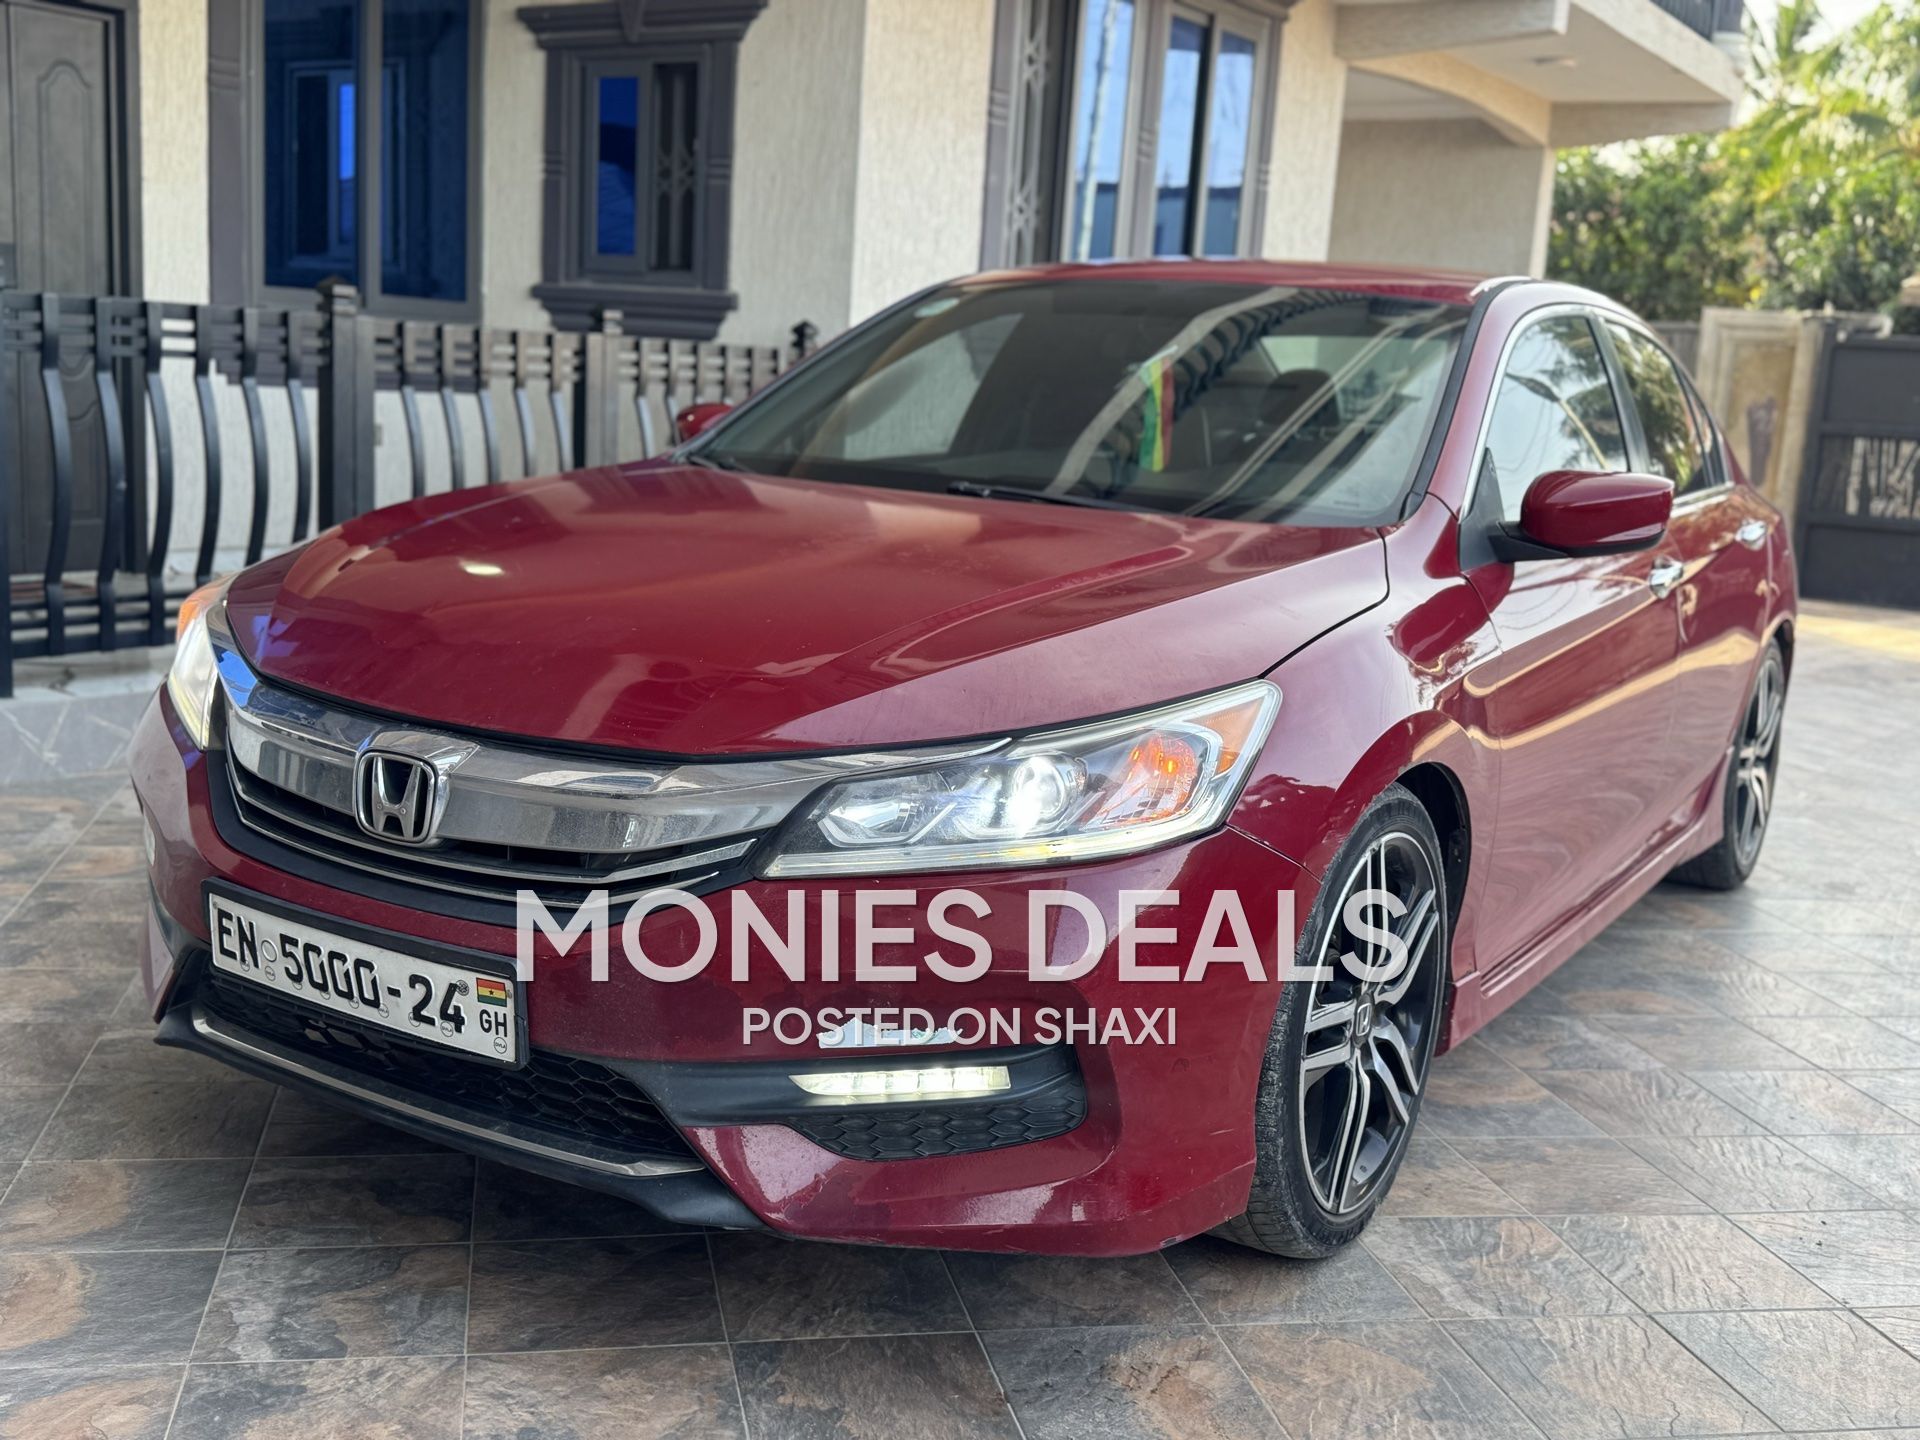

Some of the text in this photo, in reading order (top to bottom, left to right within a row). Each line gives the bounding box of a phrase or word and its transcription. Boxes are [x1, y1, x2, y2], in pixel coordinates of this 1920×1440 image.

[217, 908, 466, 1034] EN 5000-24
[479, 1008, 508, 1037] GH
